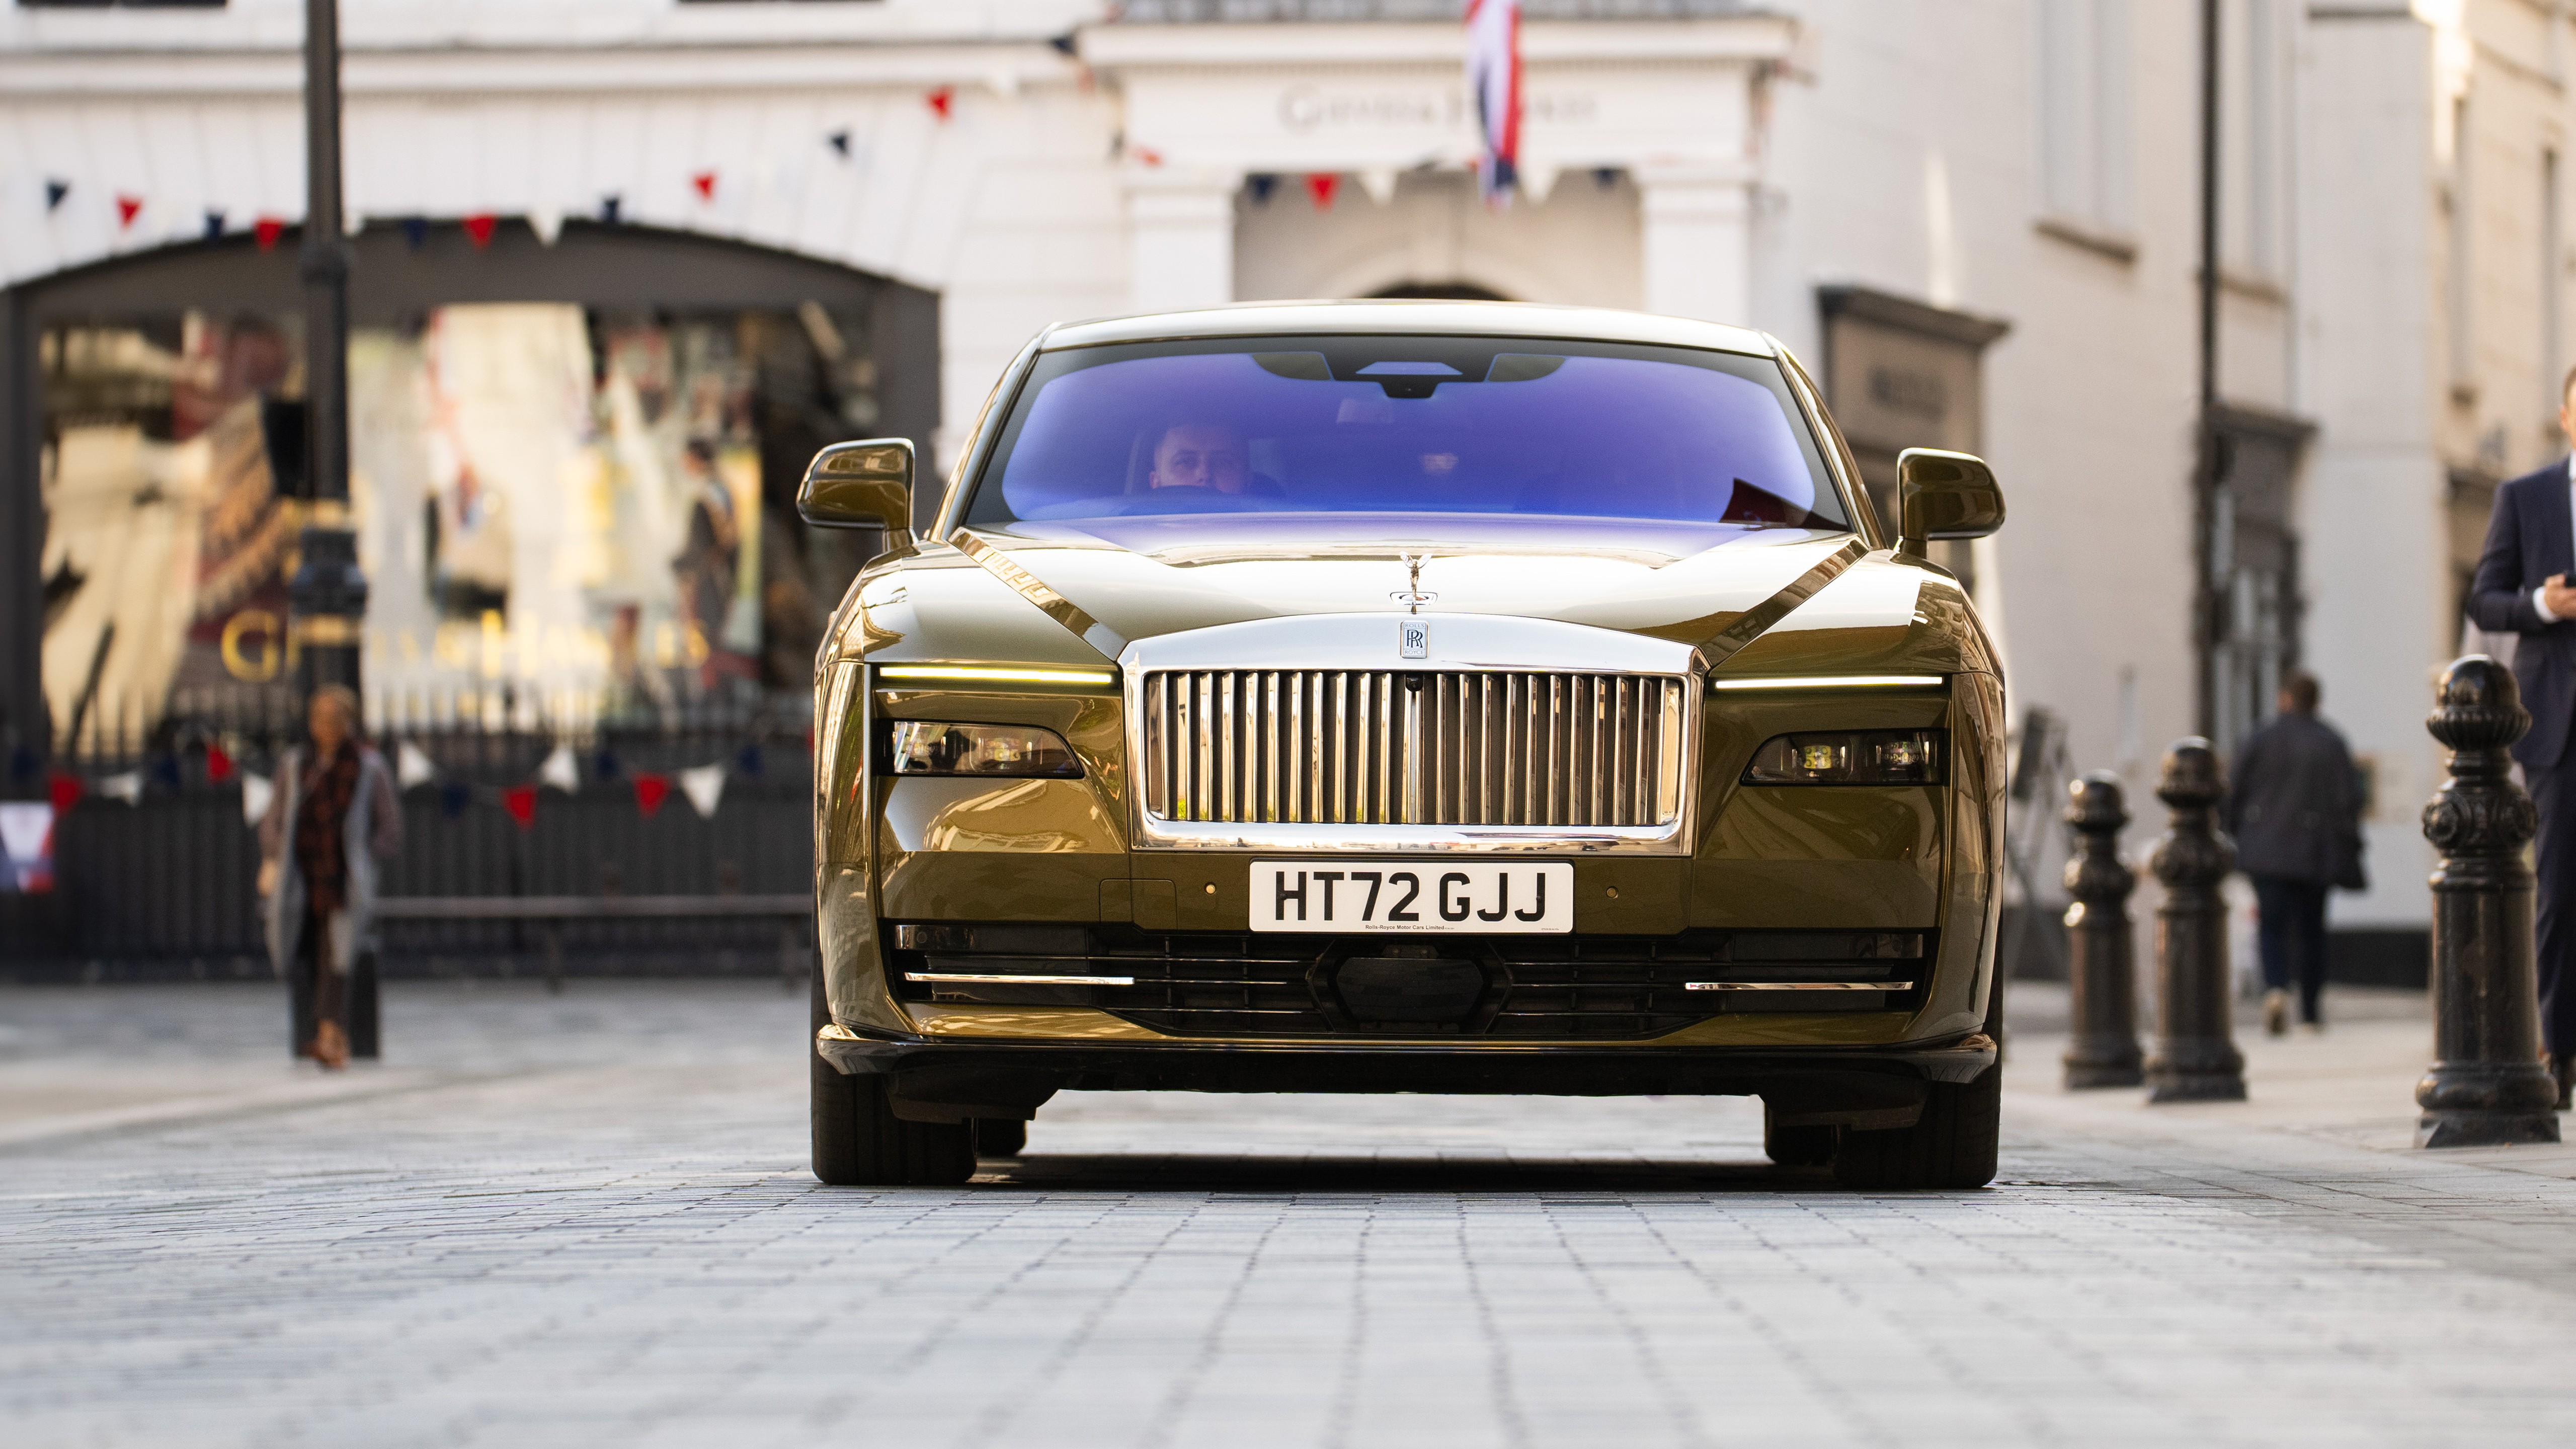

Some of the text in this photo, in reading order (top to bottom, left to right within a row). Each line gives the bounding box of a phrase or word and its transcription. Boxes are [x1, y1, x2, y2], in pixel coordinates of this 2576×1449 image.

[1407, 629, 1423, 648] RR
[1275, 871, 1546, 922] HT72 GJJ
